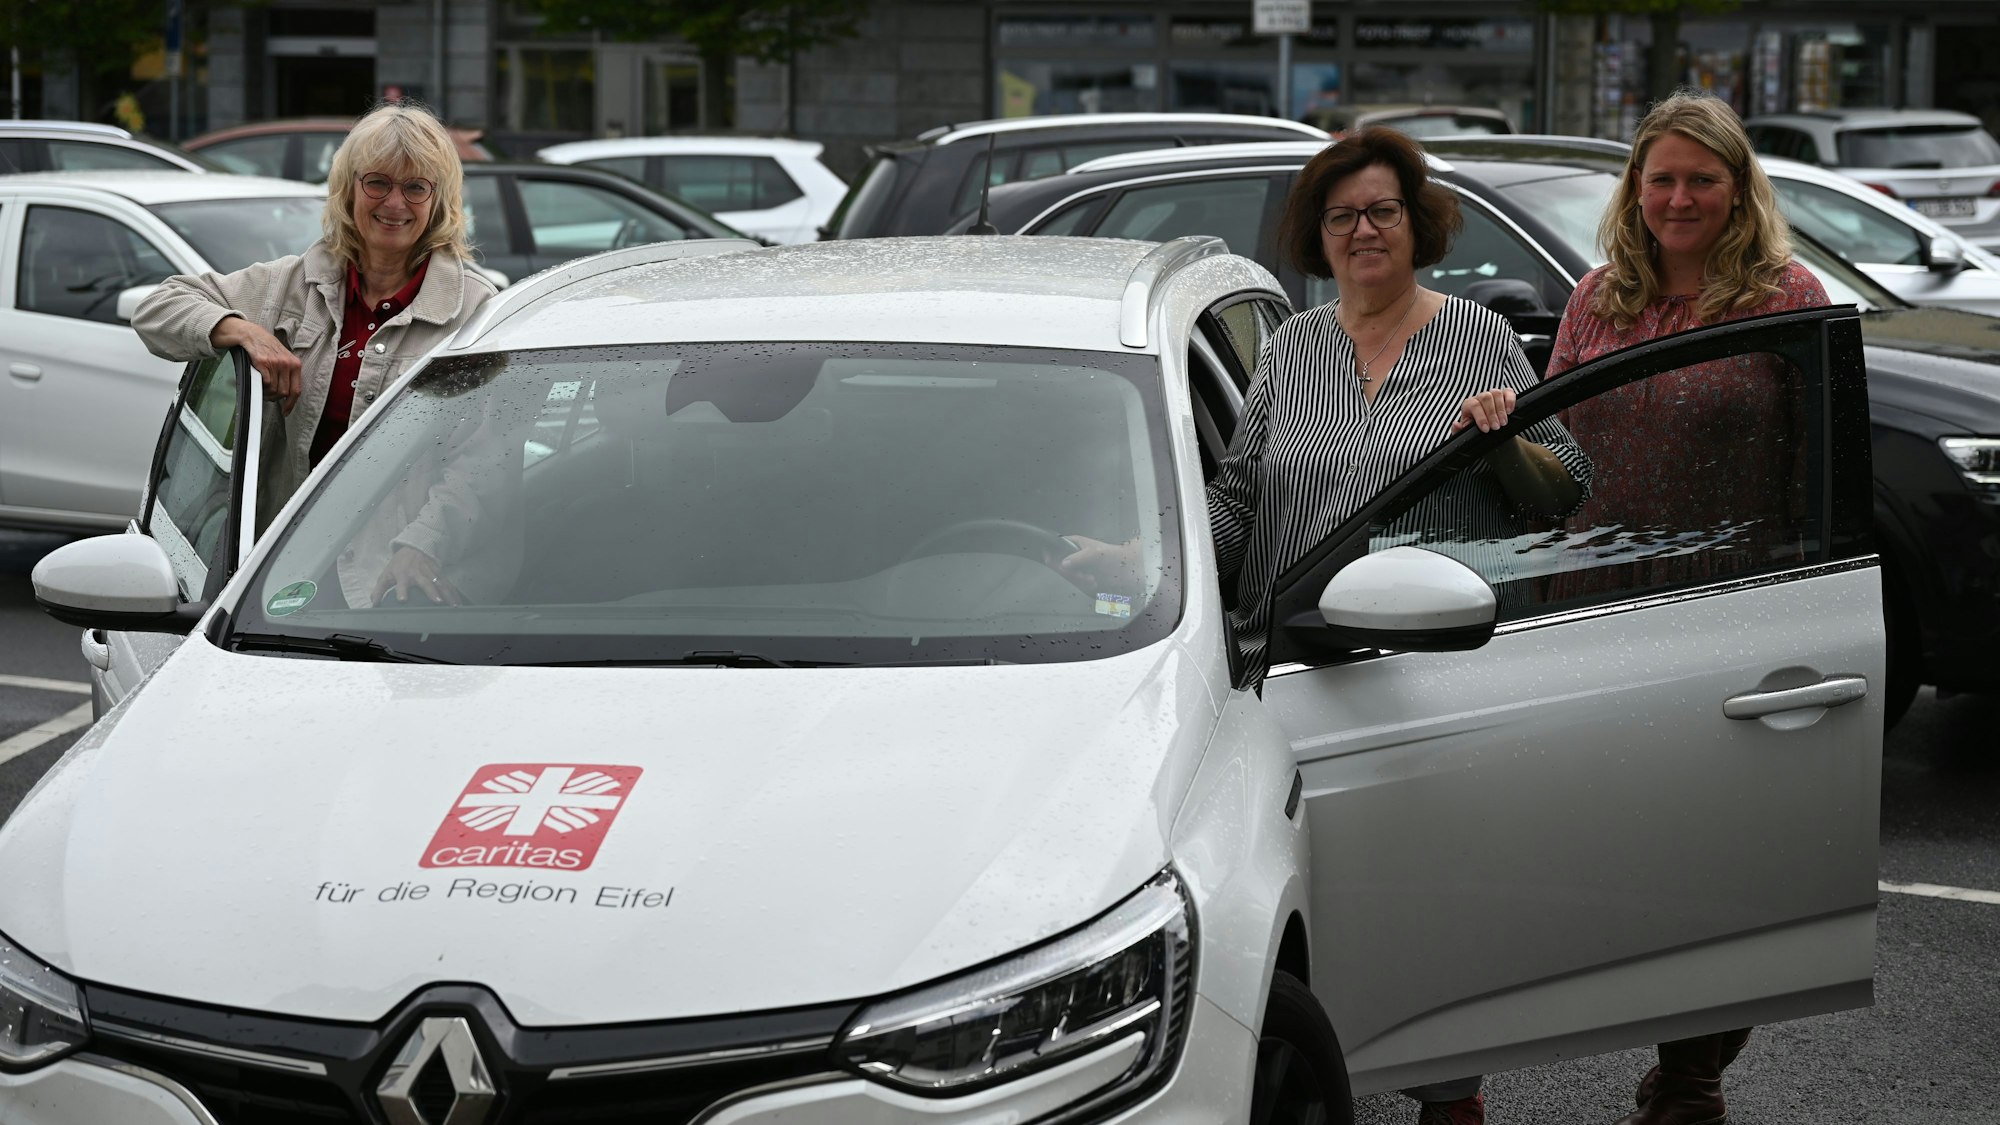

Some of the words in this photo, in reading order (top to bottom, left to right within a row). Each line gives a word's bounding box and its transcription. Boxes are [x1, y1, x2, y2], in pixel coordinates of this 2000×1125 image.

[431, 840, 584, 869] caritas
[315, 881, 365, 903] für
[377, 881, 431, 902] die
[447, 878, 577, 904] Region
[594, 886, 675, 909] Eifel
